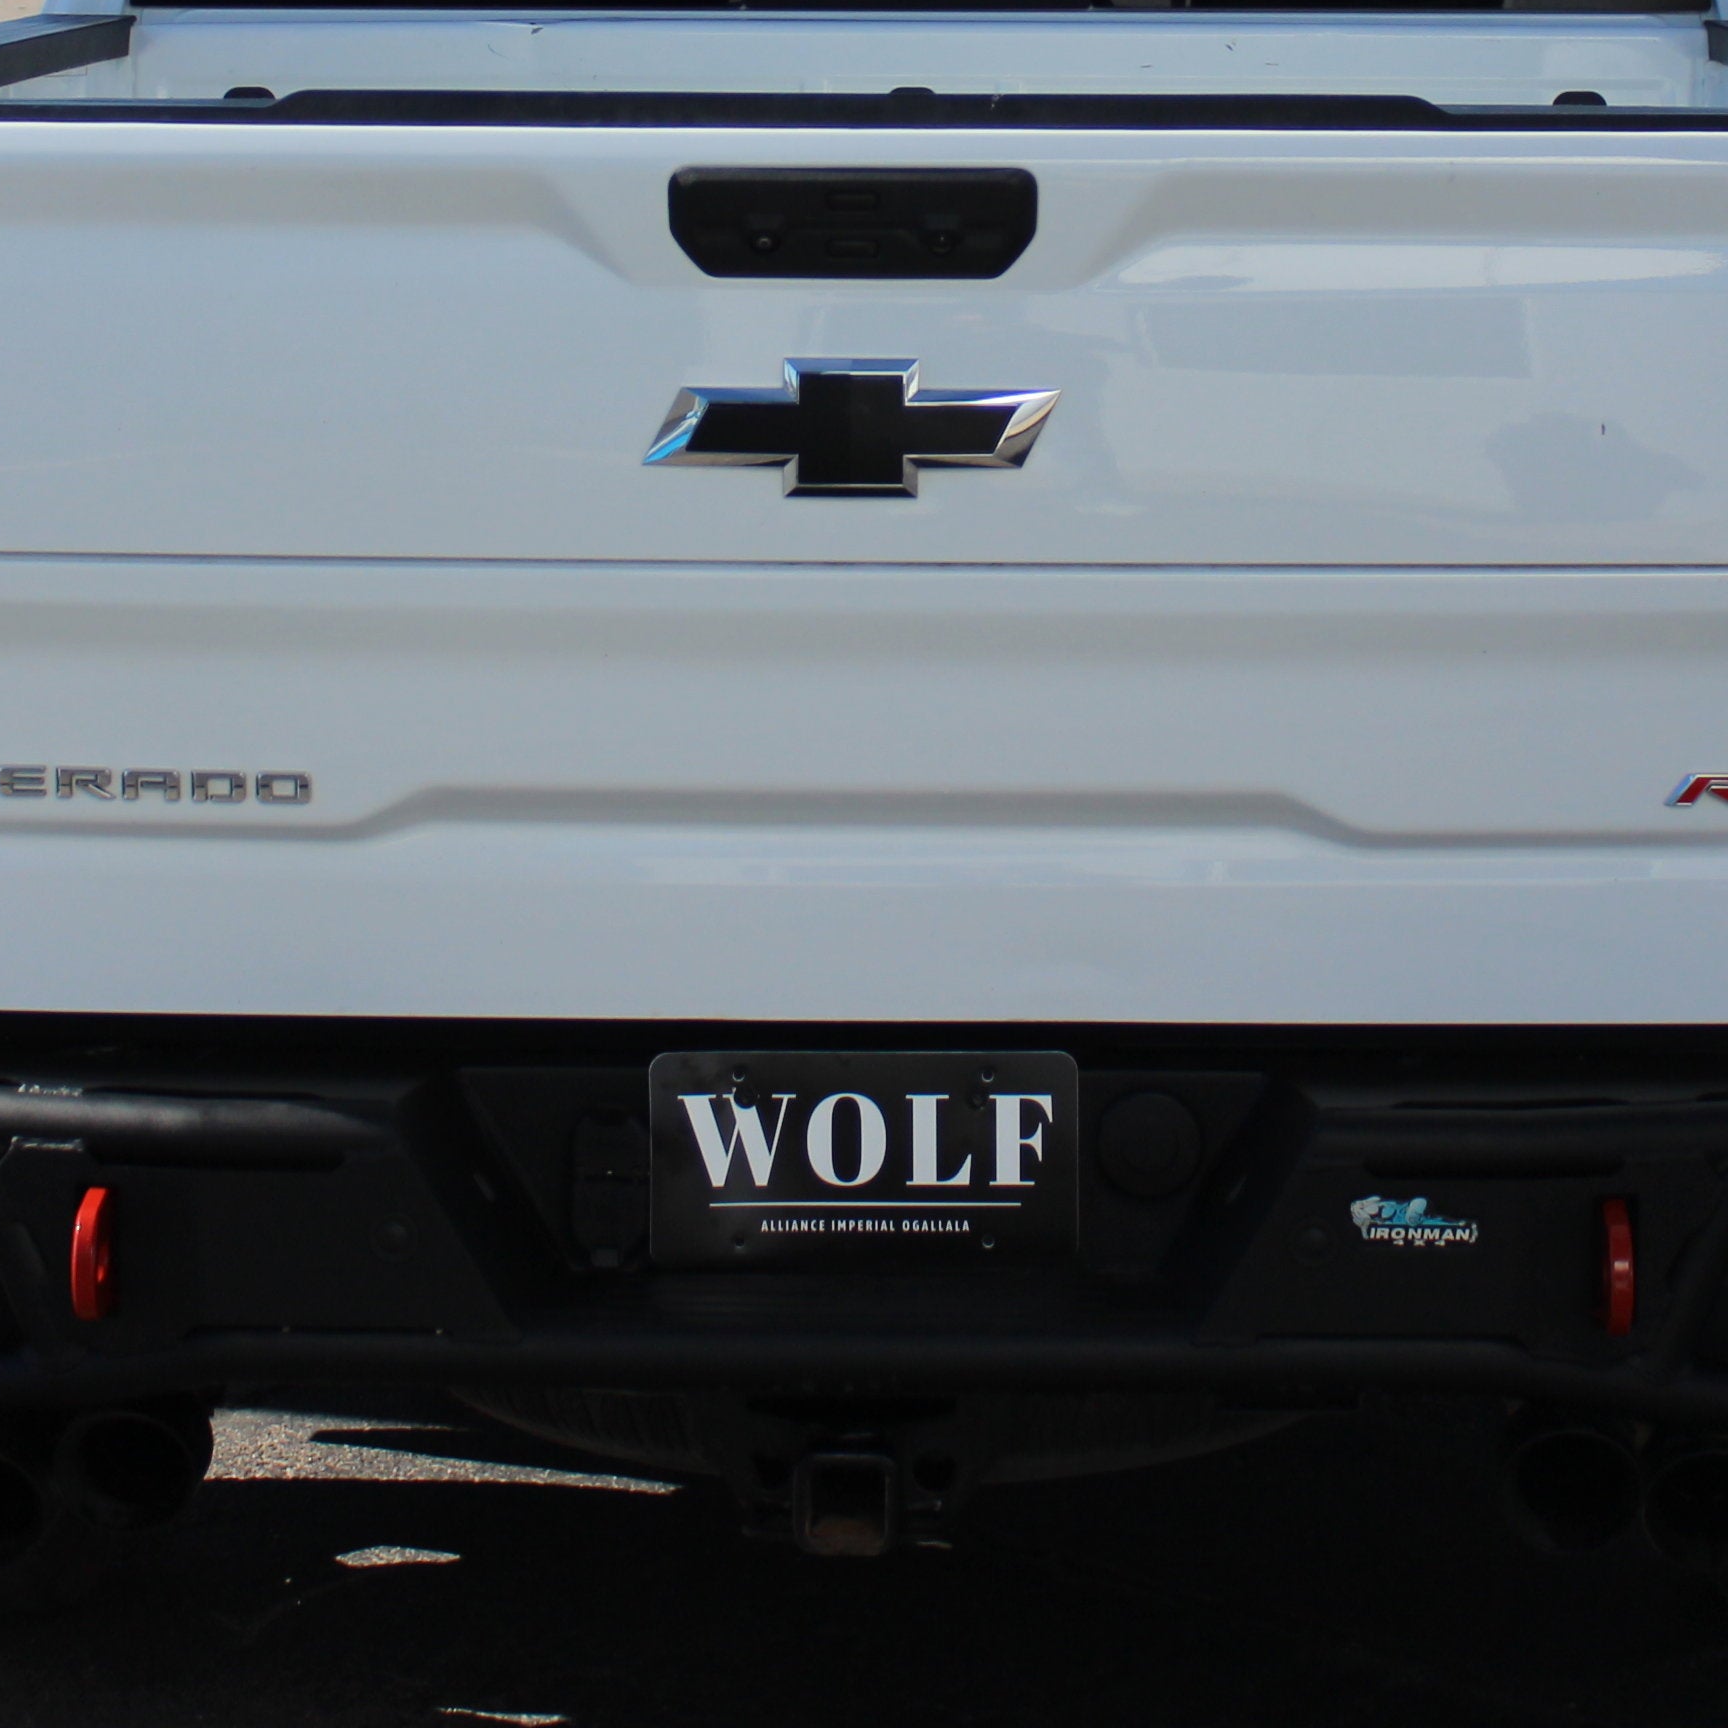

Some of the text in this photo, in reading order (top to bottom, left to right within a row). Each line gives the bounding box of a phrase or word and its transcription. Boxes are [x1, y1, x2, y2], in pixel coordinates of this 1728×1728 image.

[677, 1092, 1054, 1187] WOLF
[760, 1219, 970, 1233] ALLIANCE IMPERIAL OGALLALA
[1369, 1227, 1471, 1241] IRONMAN
